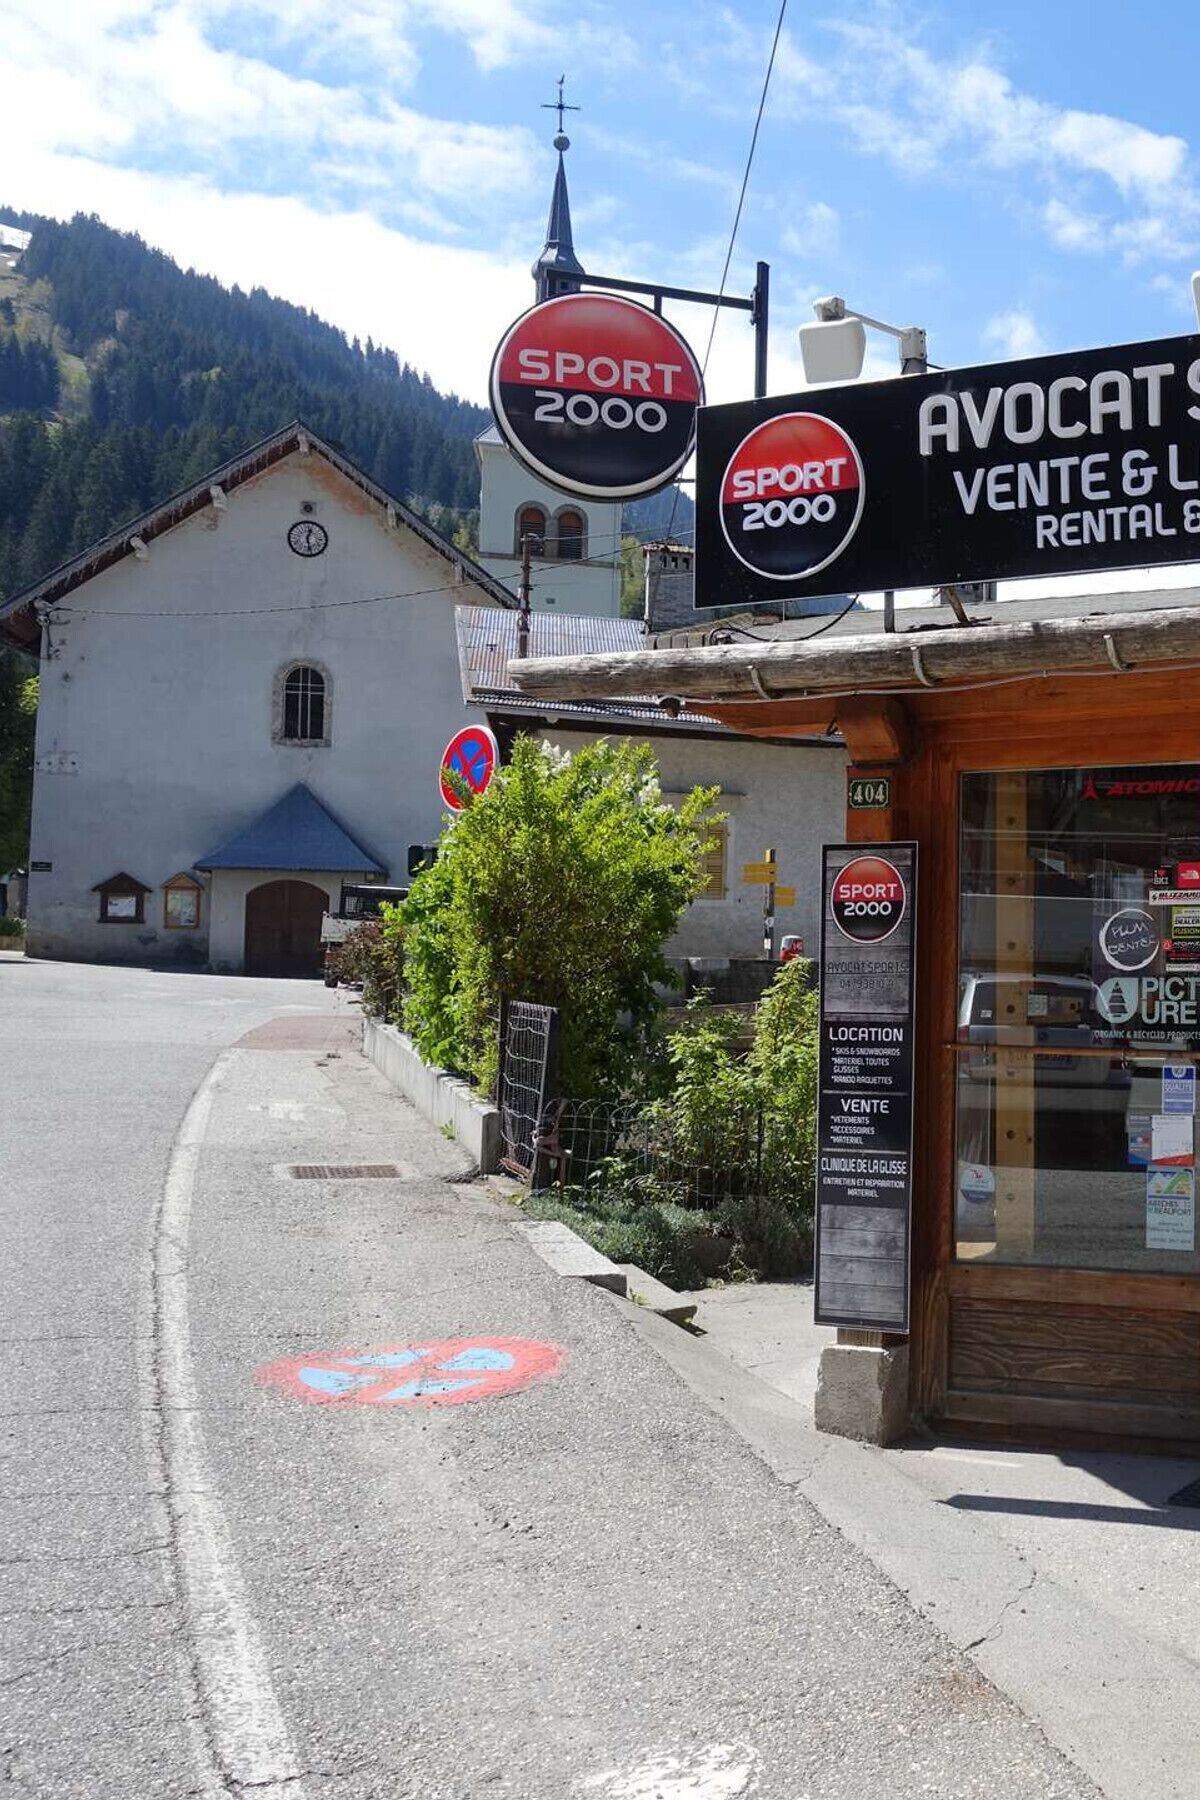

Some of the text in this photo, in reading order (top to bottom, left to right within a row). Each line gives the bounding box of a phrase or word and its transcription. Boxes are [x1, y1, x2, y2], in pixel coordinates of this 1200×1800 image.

[518, 348, 682, 394] SPORT
[534, 390, 668, 433] 2000
[918, 363, 1175, 456] AVOCAT
[732, 457, 849, 499] SPORT
[952, 451, 1110, 515] VENTE
[1121, 449, 1158, 497] &
[741, 494, 837, 531] 2000
[1036, 502, 1176, 549] RENTAL
[854, 784, 885, 803] 404
[1106, 778, 1200, 797] ATOMIC
[839, 883, 897, 899] SPORT
[844, 902, 892, 916] 2000
[827, 961, 908, 974] AVOCAT SPORTS
[1141, 1001, 1198, 1025] URE
[829, 1027, 903, 1042] LOCATION
[1095, 1030, 1125, 1040] ORGANIC
[1133, 1031, 1165, 1040] RECYCLED
[835, 1047, 850, 1055] SKIS
[856, 1048, 901, 1056] SNOWBOARDS
[833, 1065, 859, 1073] GLISSES
[865, 1058, 890, 1066] TOUTES
[857, 1076, 893, 1085] RAQUETTES
[840, 1099, 890, 1114] VENTE
[821, 1157, 908, 1175] CLINIQUE DE LA GLISSE
[822, 1177, 905, 1189] ENTRETIEN ET REPARATION
